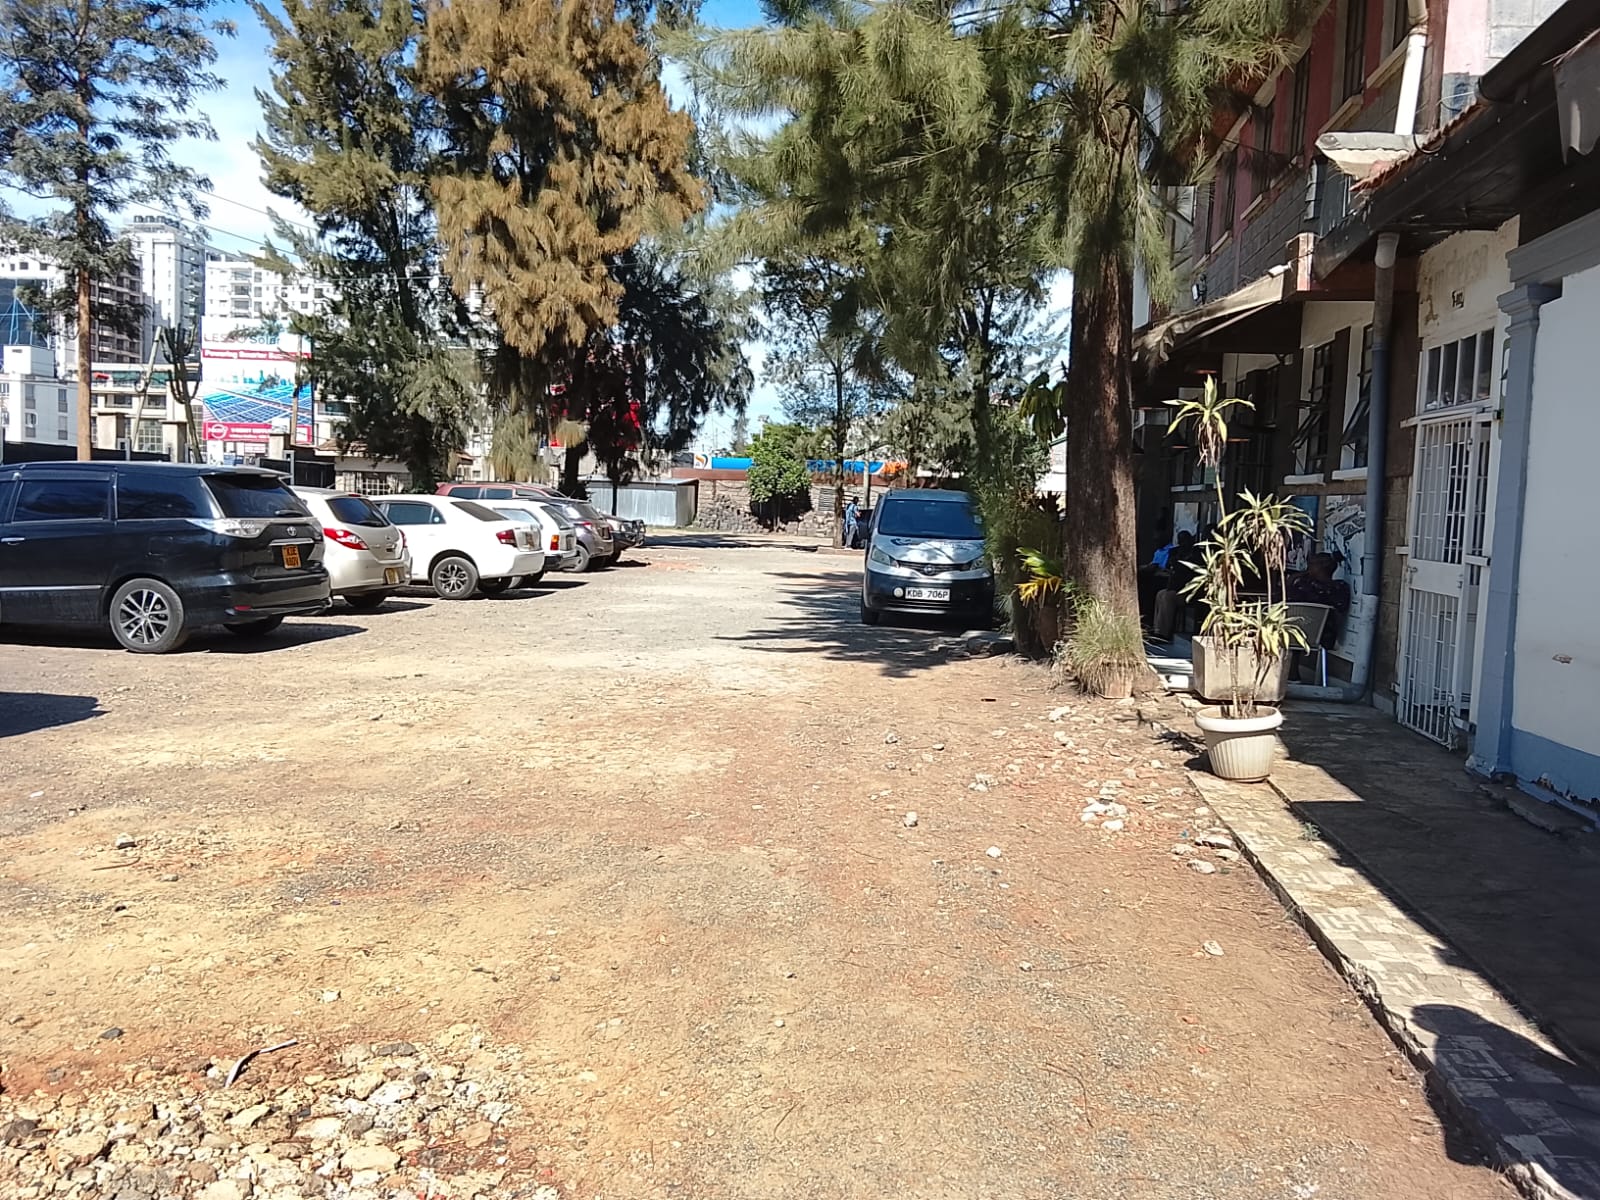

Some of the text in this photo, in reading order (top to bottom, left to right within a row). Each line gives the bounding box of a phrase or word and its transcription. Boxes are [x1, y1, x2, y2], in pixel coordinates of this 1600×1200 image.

[249, 334, 280, 345] Solar
[907, 589, 949, 599] KDB 706P
